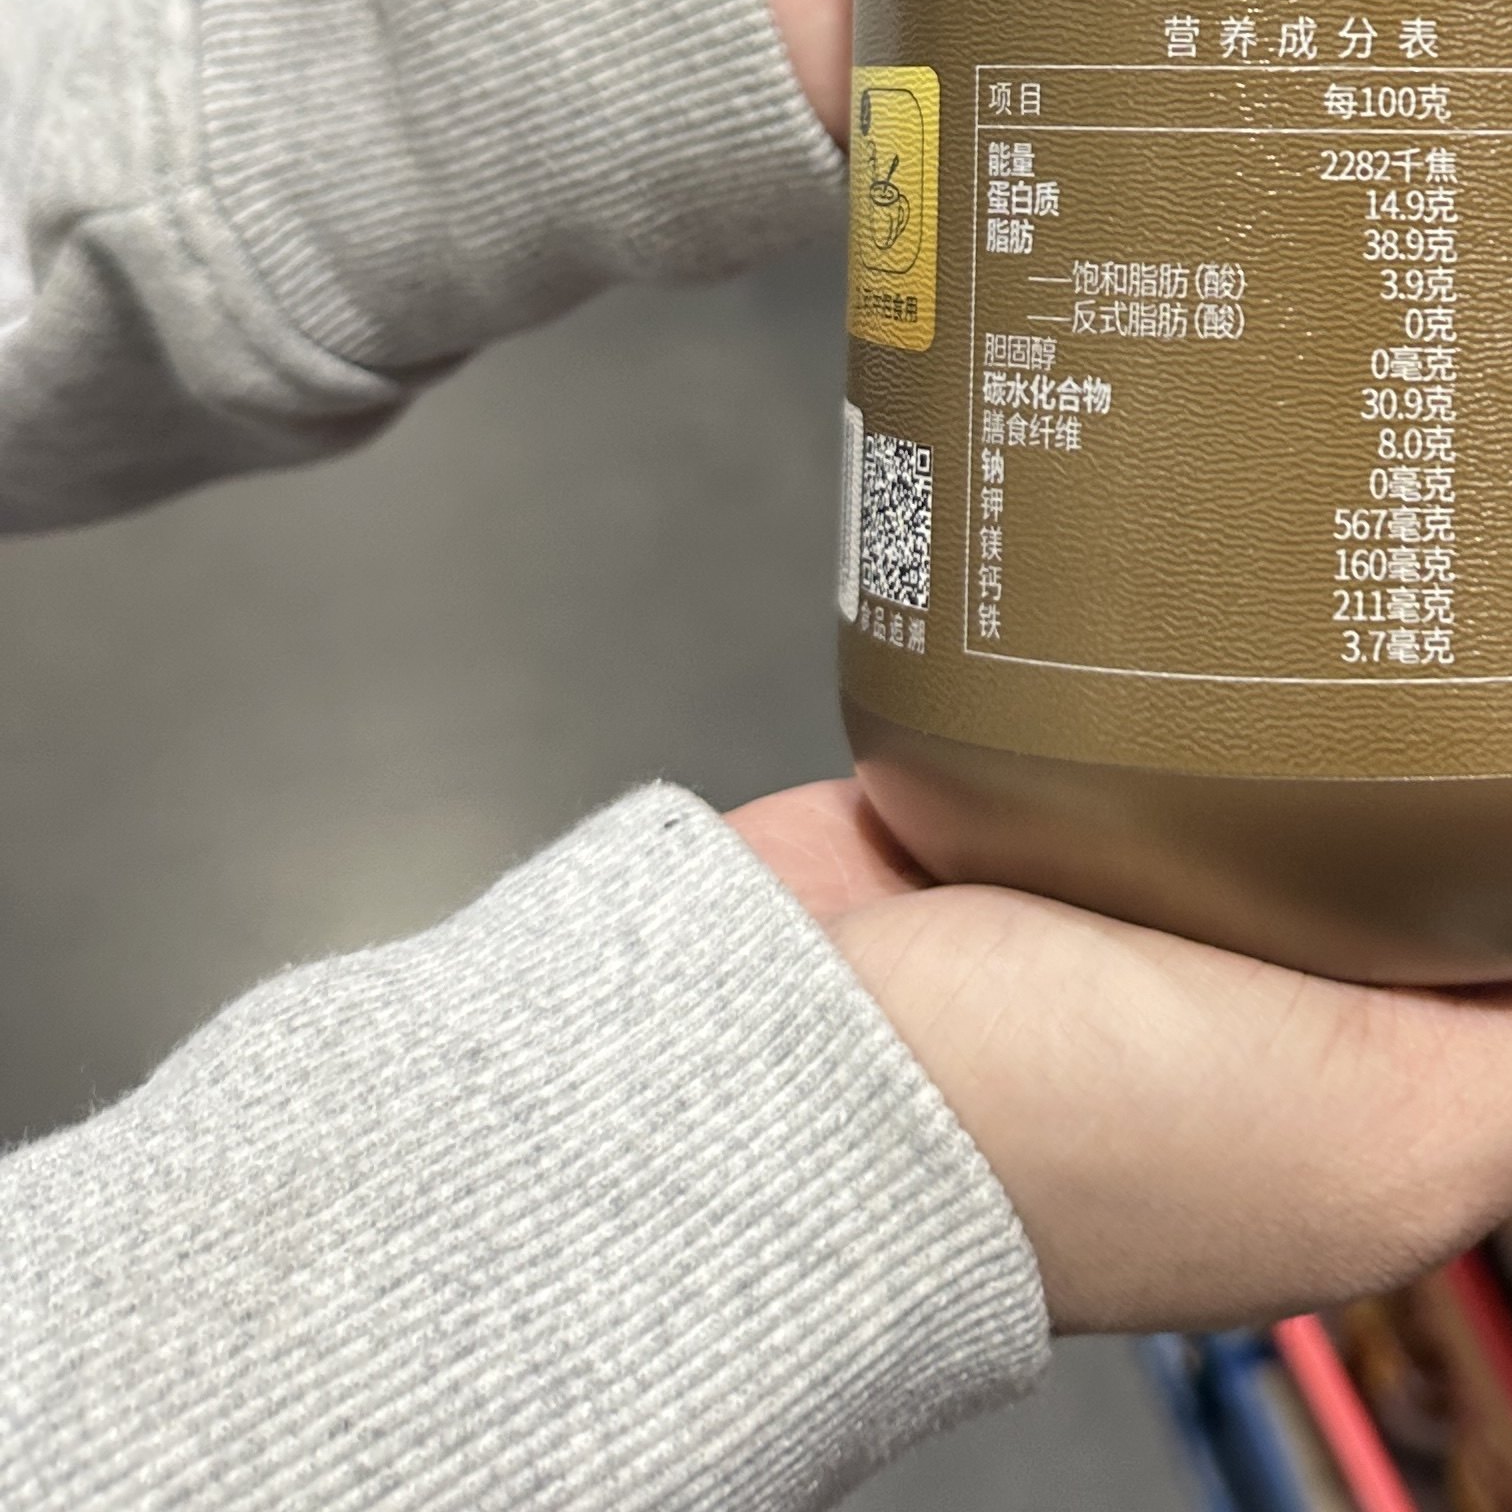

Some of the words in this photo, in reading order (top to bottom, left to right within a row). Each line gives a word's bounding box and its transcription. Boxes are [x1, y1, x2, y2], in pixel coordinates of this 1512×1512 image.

[1164, 15, 1439, 59] 营养成分表
[988, 81, 1041, 116] 项目
[1323, 84, 1452, 123] 每100克
[988, 141, 1035, 177] 能量
[1320, 147, 1459, 184] 2282千焦
[986, 180, 1060, 217] 蛋白质
[1364, 187, 1459, 224] 14.9克
[986, 218, 1034, 254] 脂肪
[1363, 227, 1458, 264] 38.9克
[1380, 266, 1458, 303] 3.9克
[1404, 306, 1457, 343] 0克
[983, 332, 1058, 371] 胆固醇
[1370, 345, 1457, 382] 0毫克
[982, 371, 1112, 415] 碳水化合物
[1360, 385, 1457, 422] 30.9克
[981, 409, 1083, 451] 膳食纤维
[1377, 425, 1456, 462] 8.0克
[981, 447, 1005, 484] 钠
[1369, 464, 1456, 503] 0毫克
[980, 485, 1004, 523] 钾
[1333, 504, 1456, 543] 567毫克
[979, 525, 1003, 562] 镁
[1333, 545, 1456, 583] 160毫克
[978, 565, 1002, 602] 钙
[1332, 585, 1455, 624] 211毫克
[978, 602, 1001, 639] 铁
[1341, 626, 1455, 665] 3.7毫克
